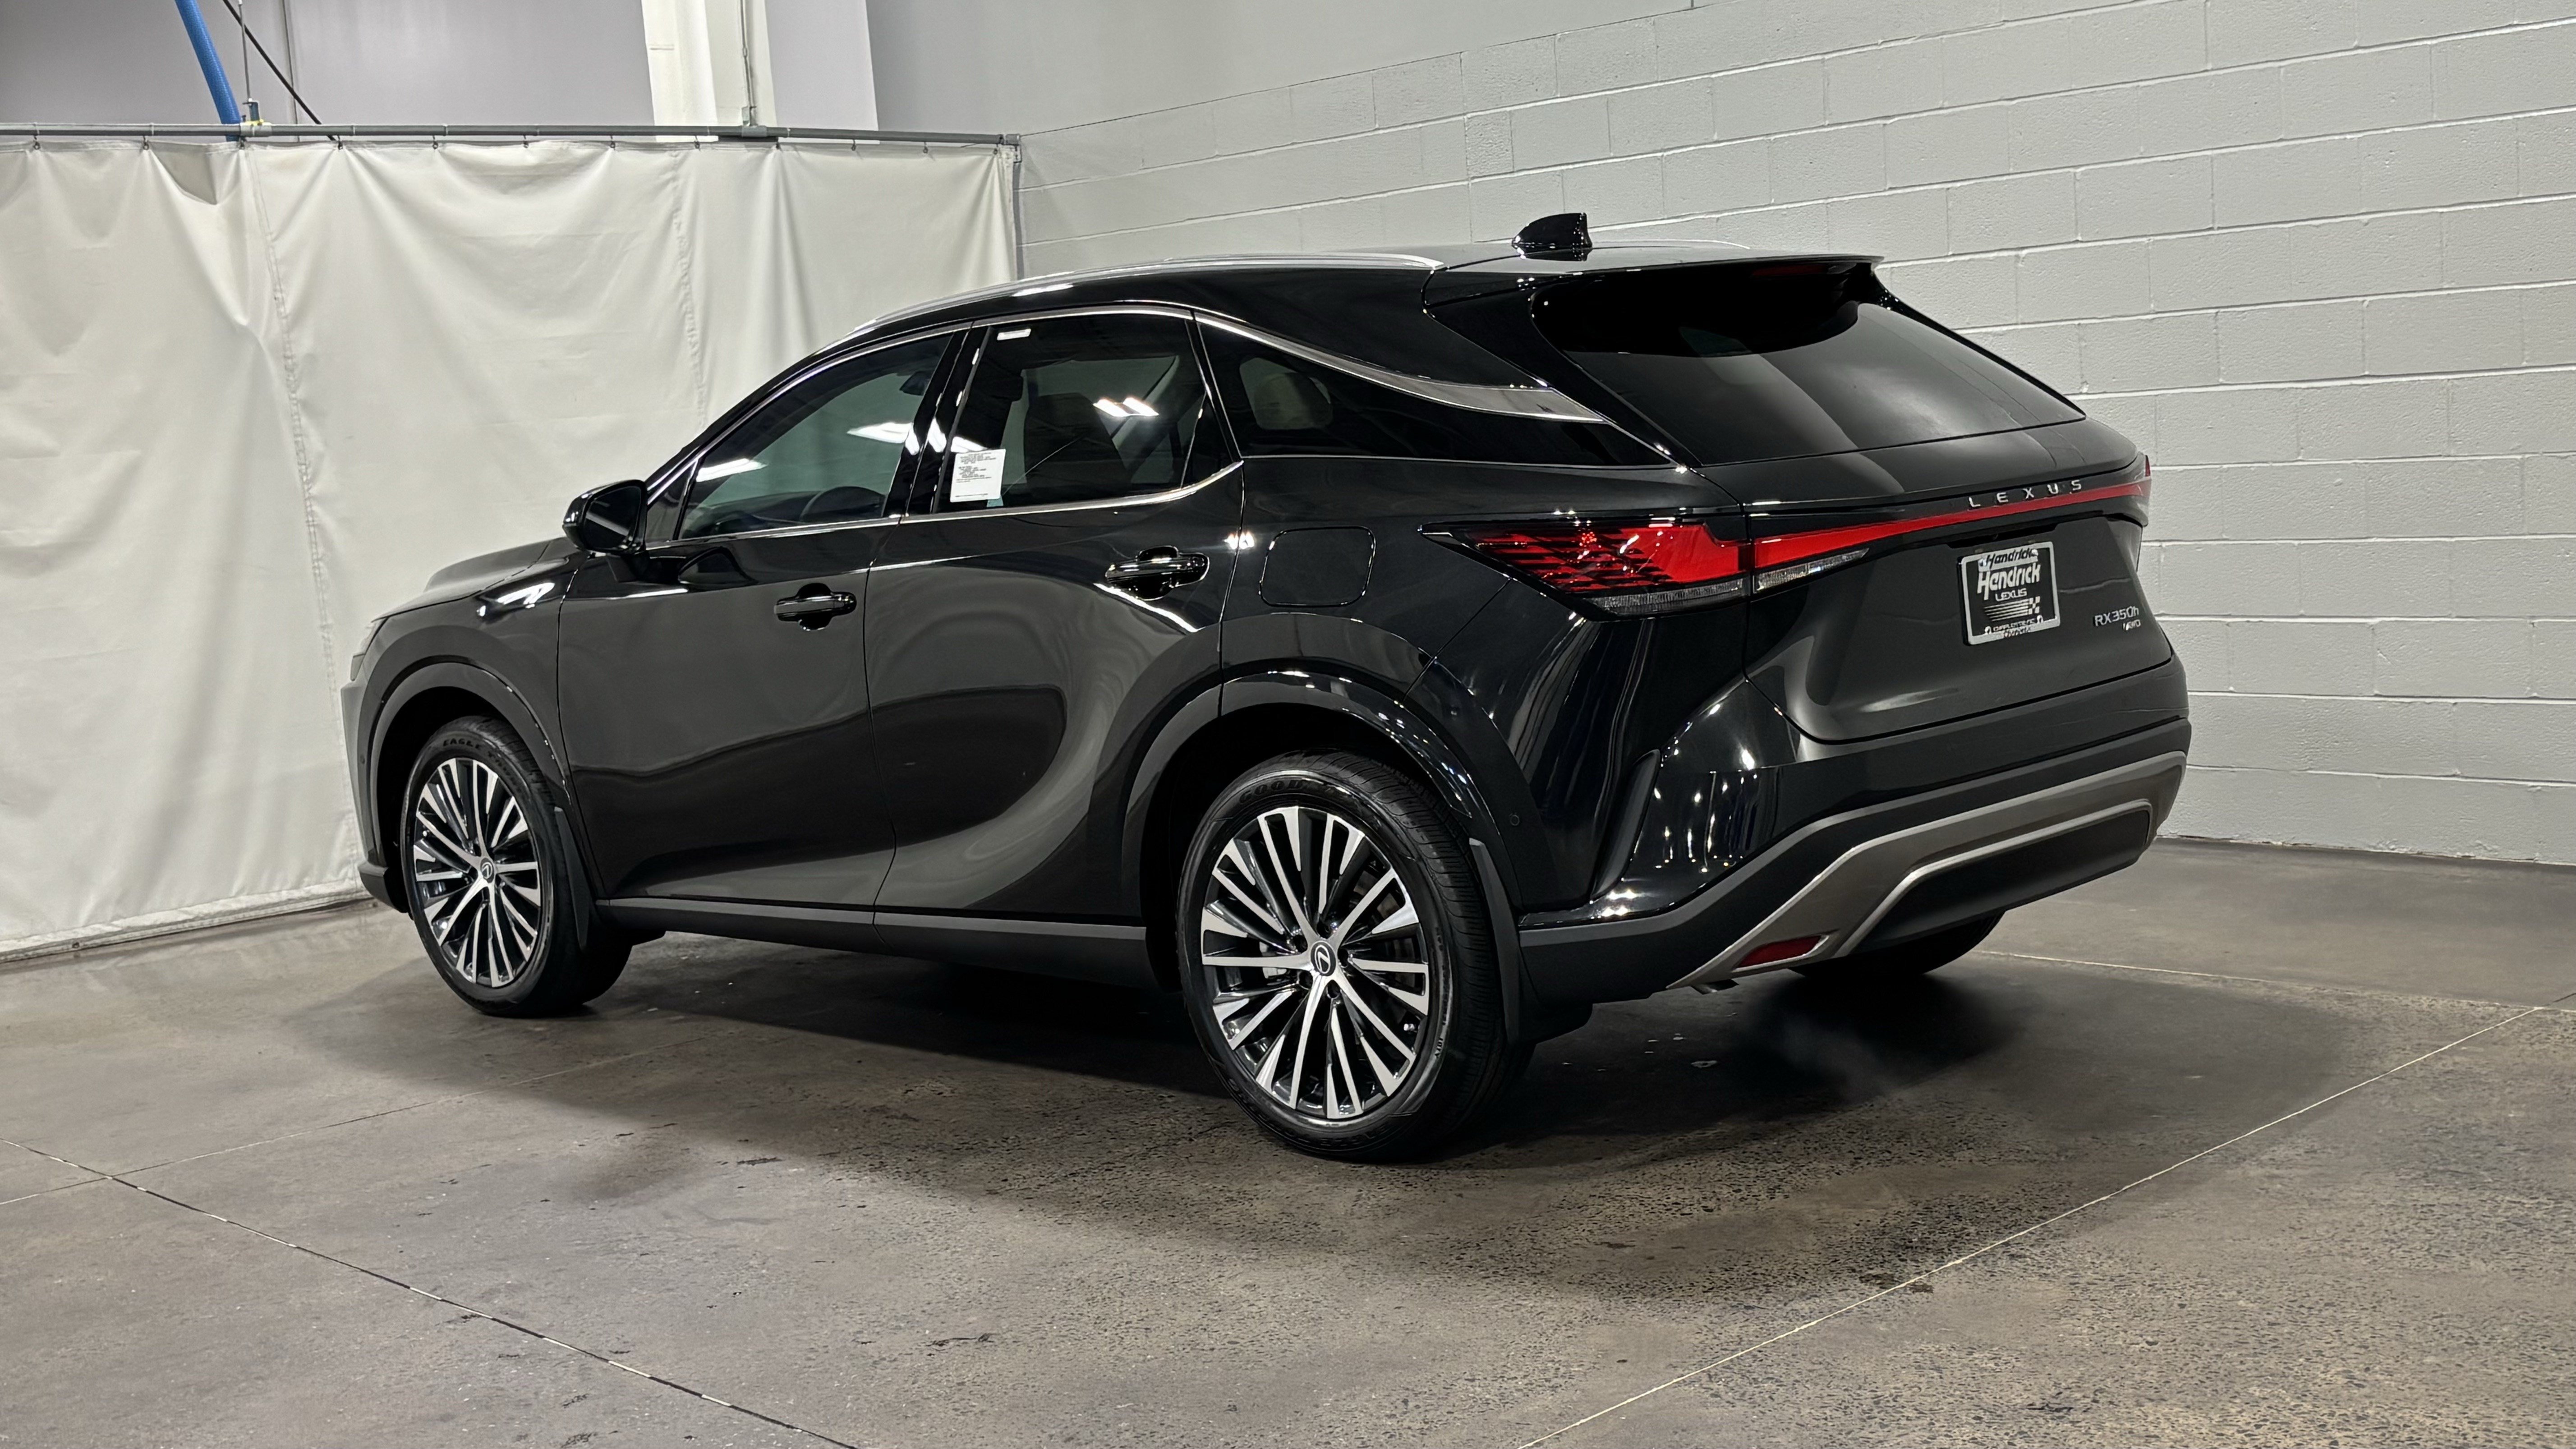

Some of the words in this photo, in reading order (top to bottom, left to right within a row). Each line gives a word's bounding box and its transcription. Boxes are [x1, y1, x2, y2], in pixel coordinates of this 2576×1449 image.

[1969, 480, 2082, 507] LEXUS
[1977, 562, 2041, 600] Hendrick
[1995, 588, 2028, 602] LEXUS
[443, 738, 483, 750] EAGLE
